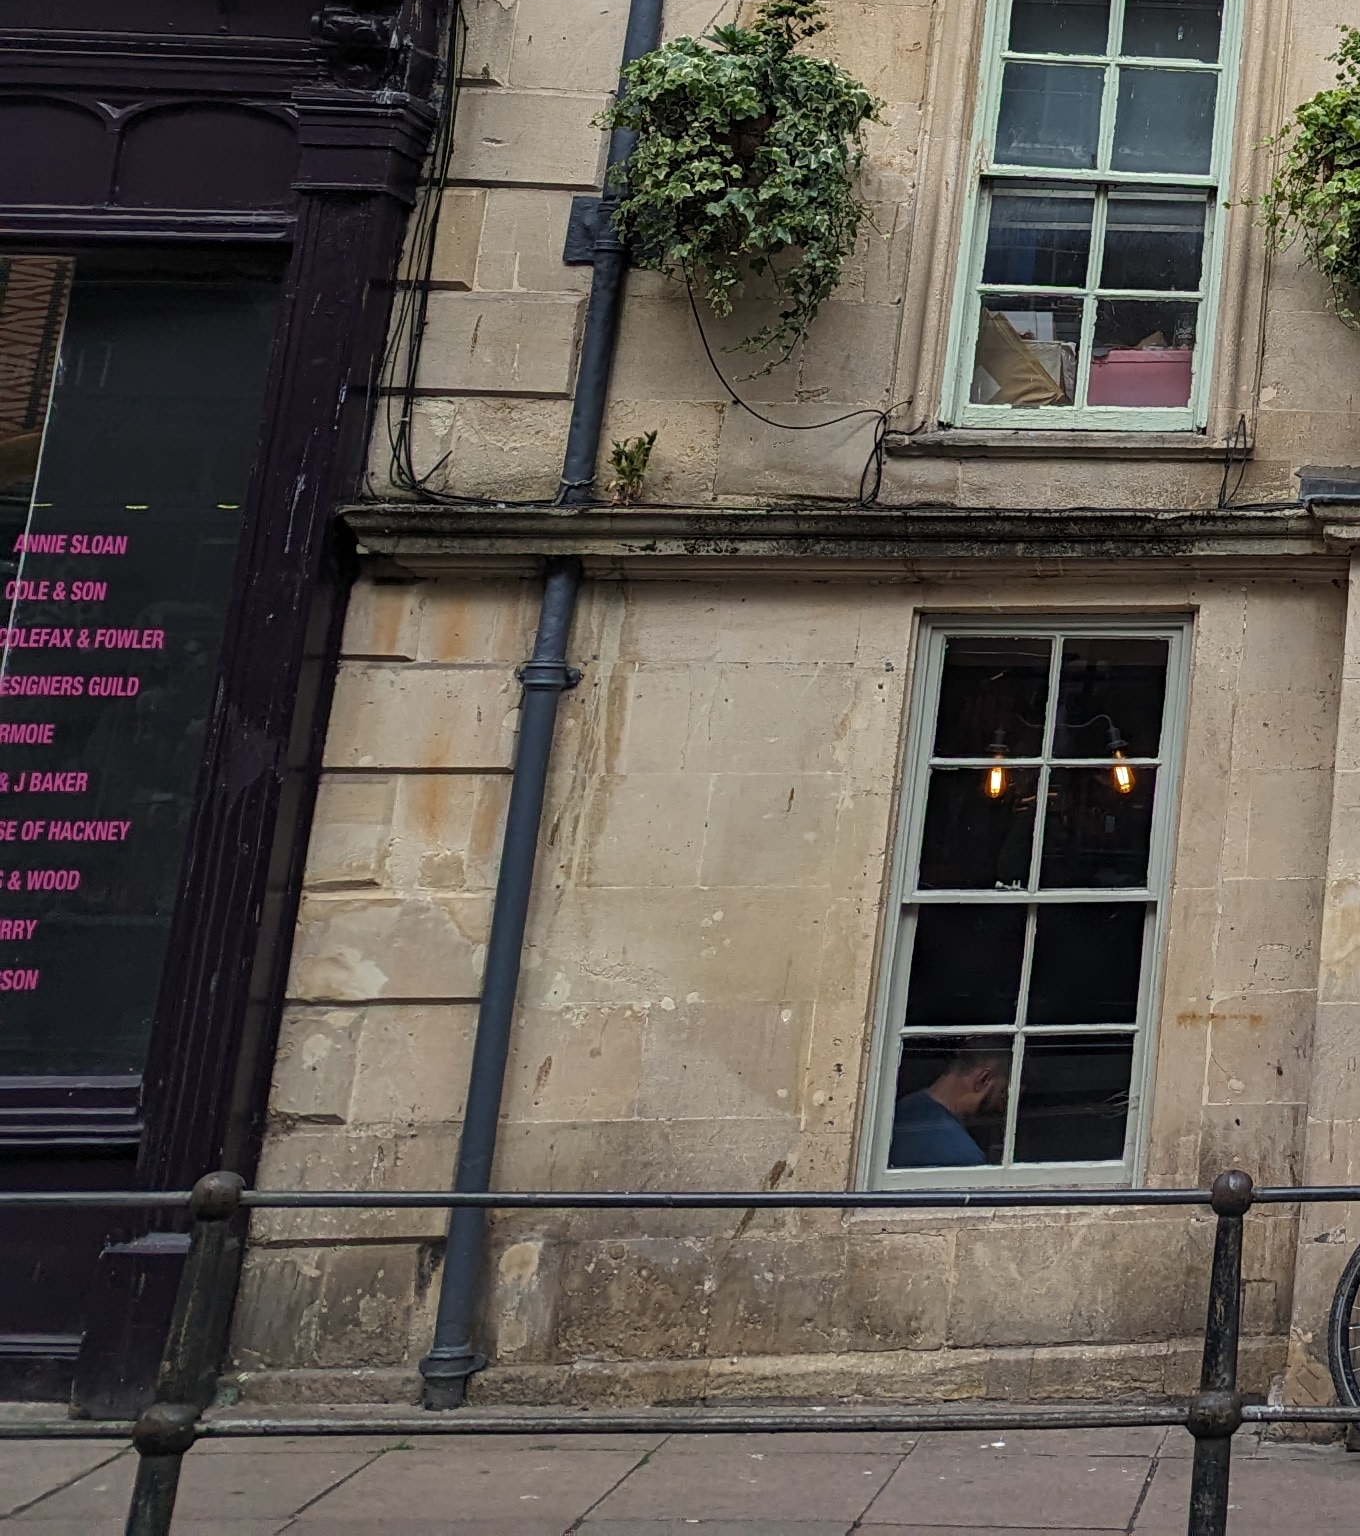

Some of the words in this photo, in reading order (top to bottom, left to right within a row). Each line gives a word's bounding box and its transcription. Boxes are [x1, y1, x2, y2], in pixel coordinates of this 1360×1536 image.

[13, 534, 68, 554] ANNIE
[70, 535, 128, 555] SLOAN
[5, 580, 50, 600] COLE
[52, 581, 66, 600] &
[70, 581, 108, 601] SON
[0, 627, 74, 648] COLEFAX
[77, 628, 90, 649] &
[94, 629, 165, 650] FOWLER
[0, 675, 85, 696] ESIGNERS
[88, 676, 140, 697] GUILD
[0, 723, 55, 744] RMOIE
[13, 772, 26, 792] J
[29, 772, 89, 792] BAKER
[21, 820, 46, 841] OF
[47, 821, 132, 841] HACKNEY
[7, 870, 22, 890] &
[27, 870, 81, 890] WOOD
